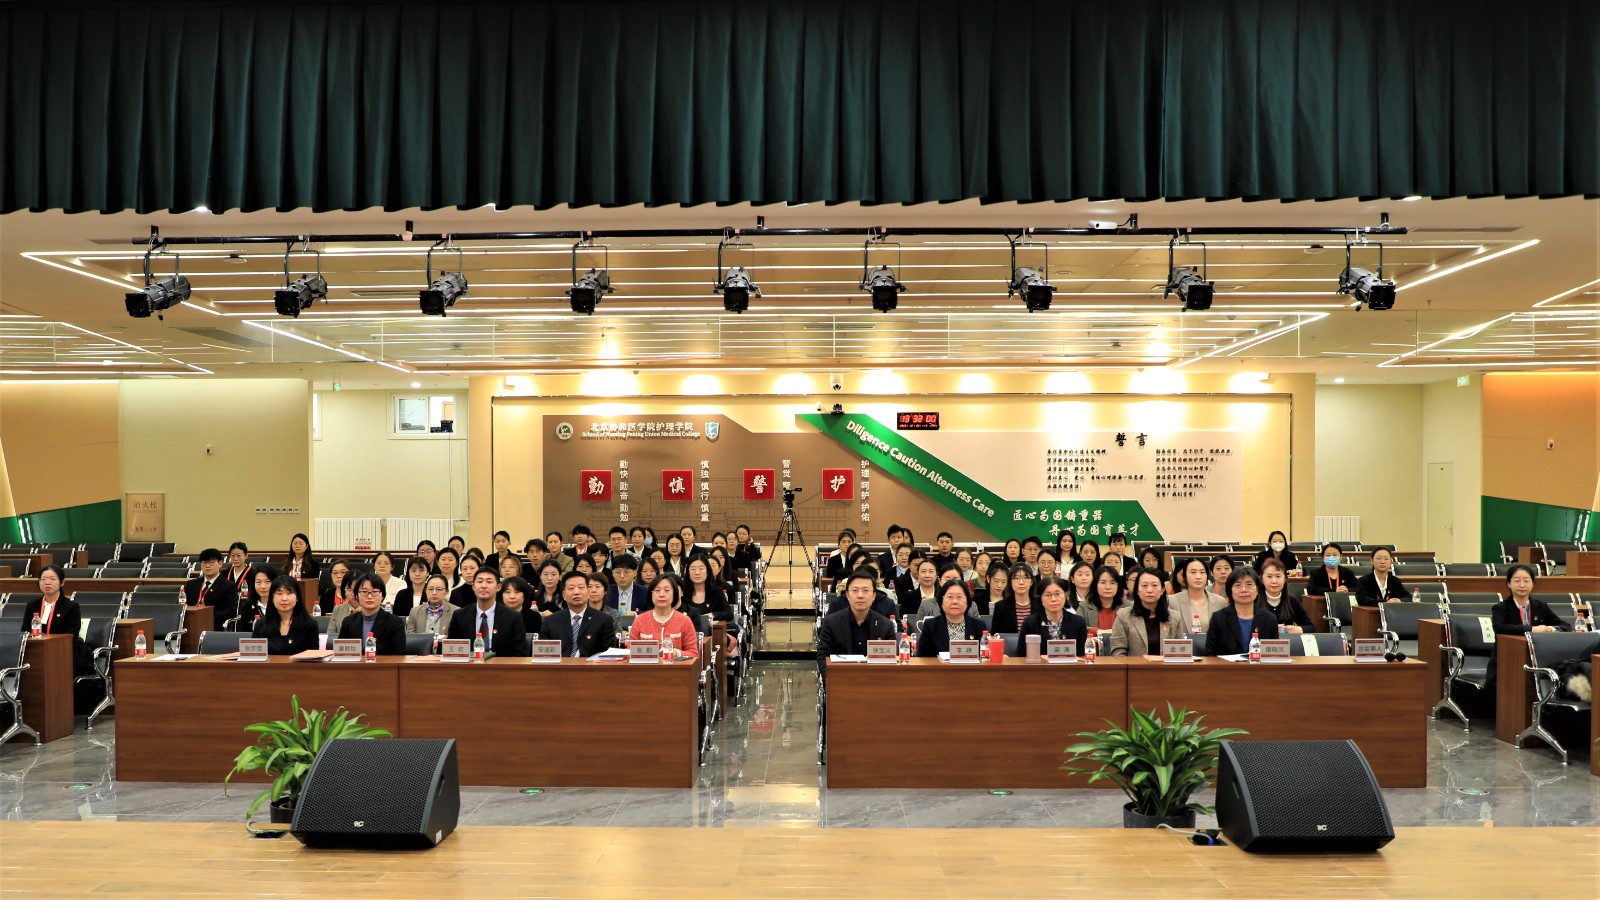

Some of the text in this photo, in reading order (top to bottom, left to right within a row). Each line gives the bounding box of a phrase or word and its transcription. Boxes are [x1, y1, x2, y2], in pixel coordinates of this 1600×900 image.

[590, 421, 694, 431] 北京协和医学院护理学院
[926, 415, 937, 423] 00
[846, 420, 995, 518] Diligence Caution Alterness Care
[588, 475, 605, 495] 勤
[668, 476, 686, 494] 慎
[750, 474, 768, 494] 警
[830, 475, 846, 493] 护
